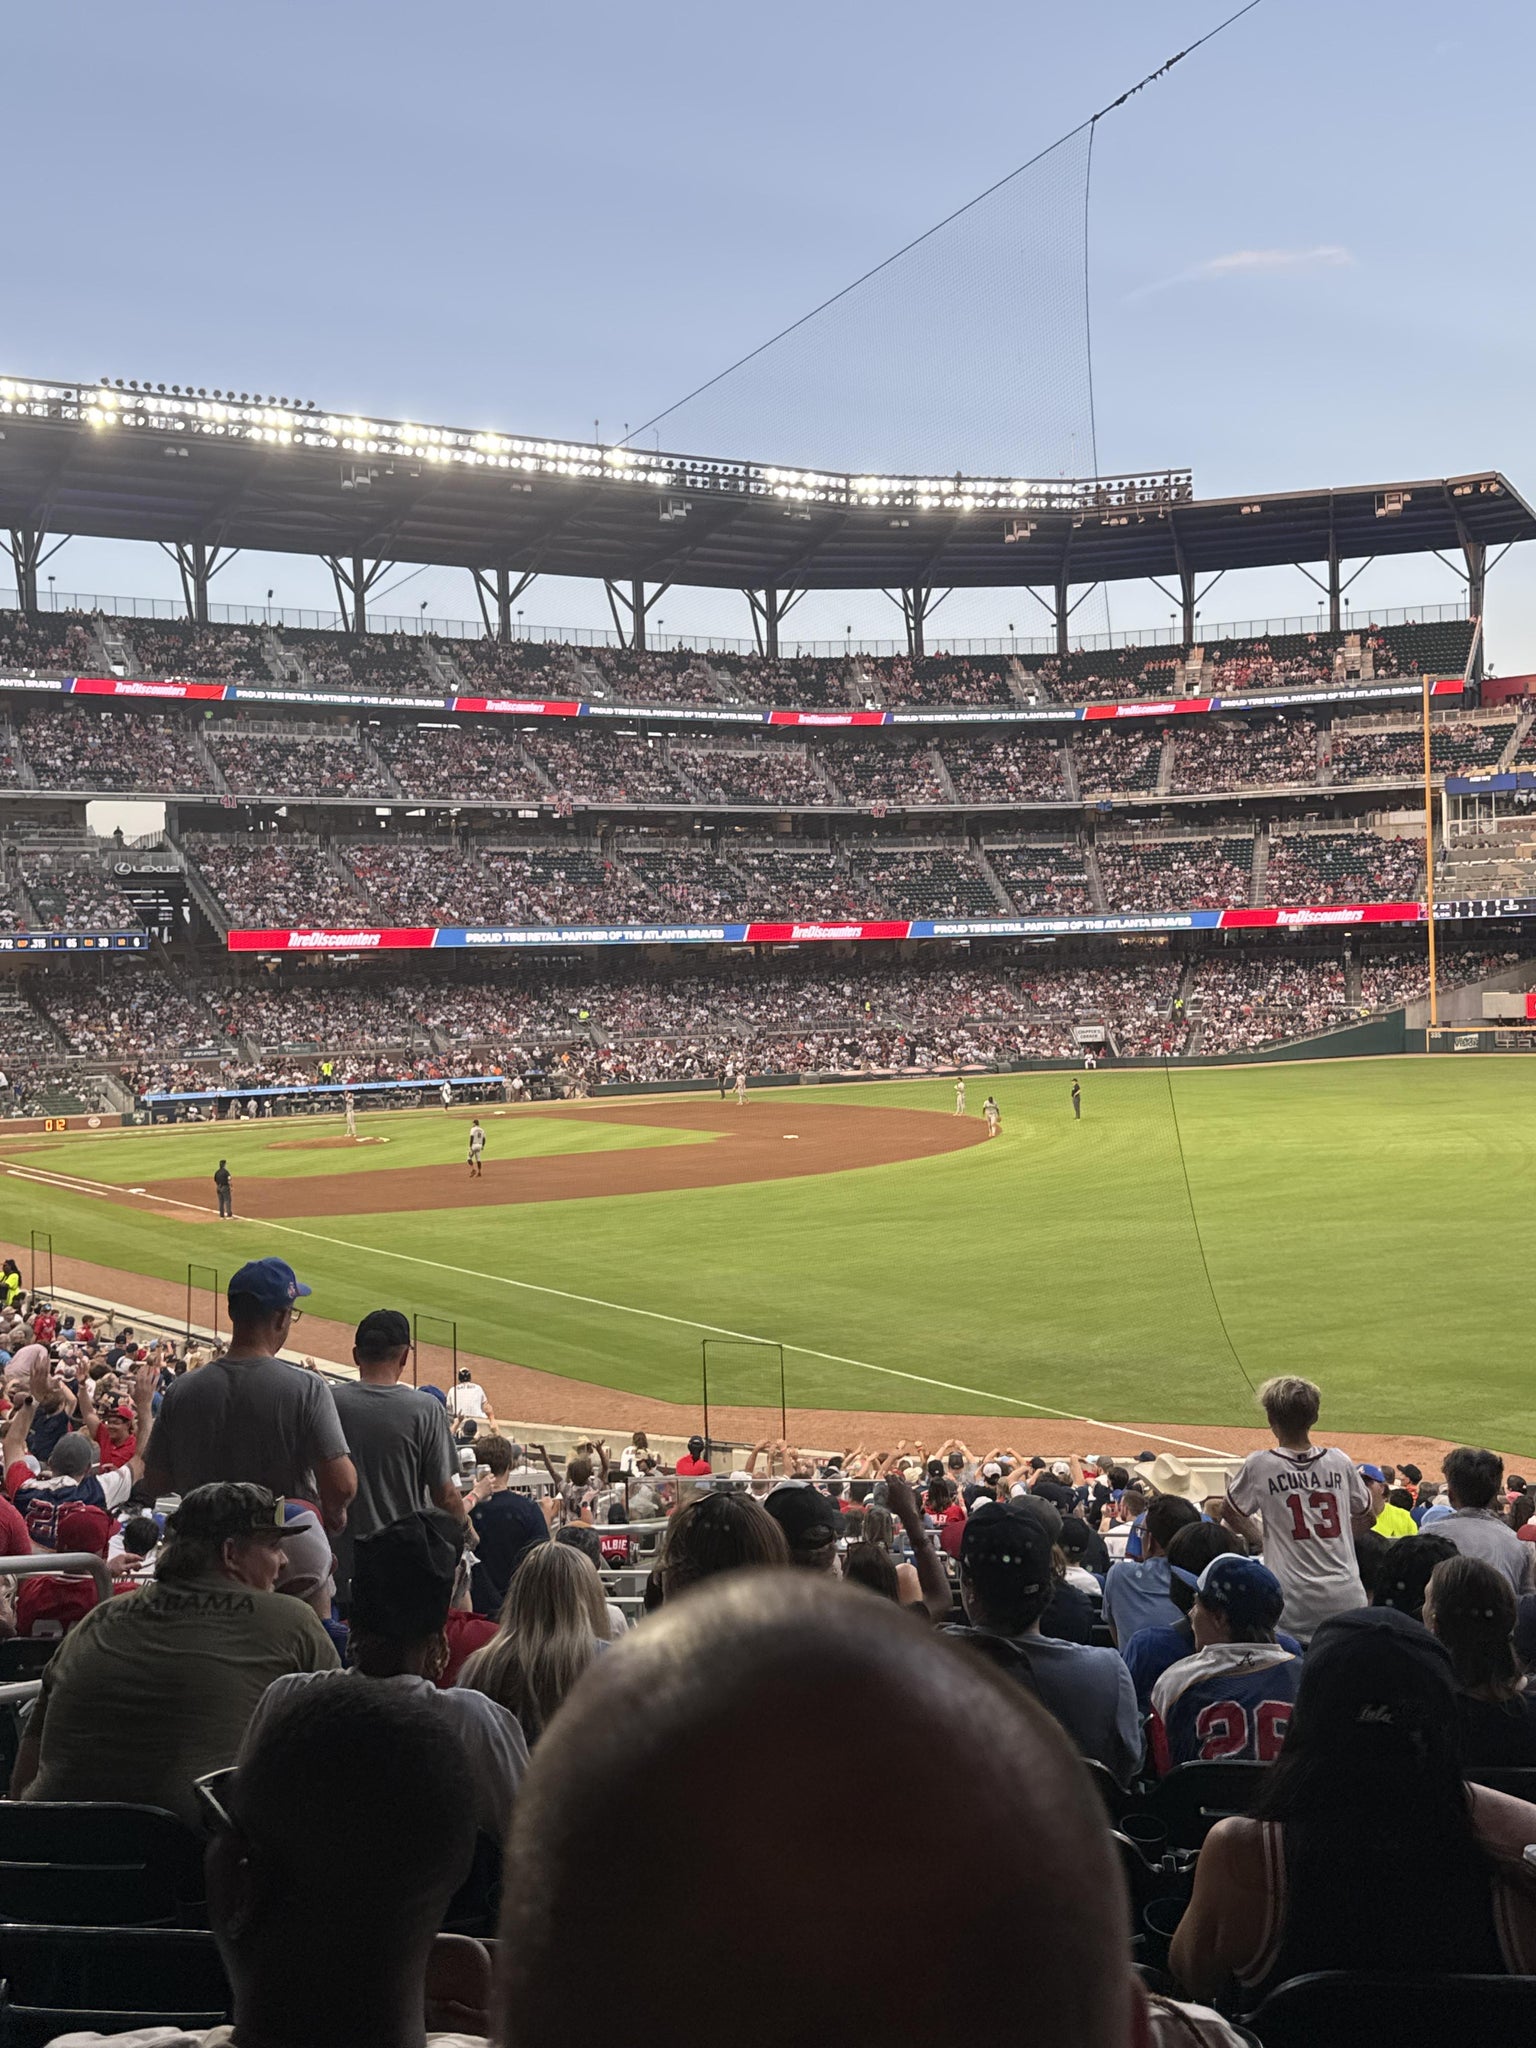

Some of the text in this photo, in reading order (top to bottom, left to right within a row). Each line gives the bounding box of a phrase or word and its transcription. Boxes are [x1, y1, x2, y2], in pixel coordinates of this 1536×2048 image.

[220, 794, 237, 808] 41
[132, 865, 180, 873] LEXUS
[1276, 910, 1364, 924] TireDiscounters
[934, 917, 1192, 934] PROUD TIRE RETAIL PARTNER OF THE ATLANTA BRAVES
[287, 932, 381, 947] TireDiscounters
[465, 929, 724, 942] PROUD TIRE RETAIL PARTNER OF THE ATLANTA BRAVES
[1325, 1471, 1342, 1490] JR
[1286, 1491, 1341, 1540] 13
